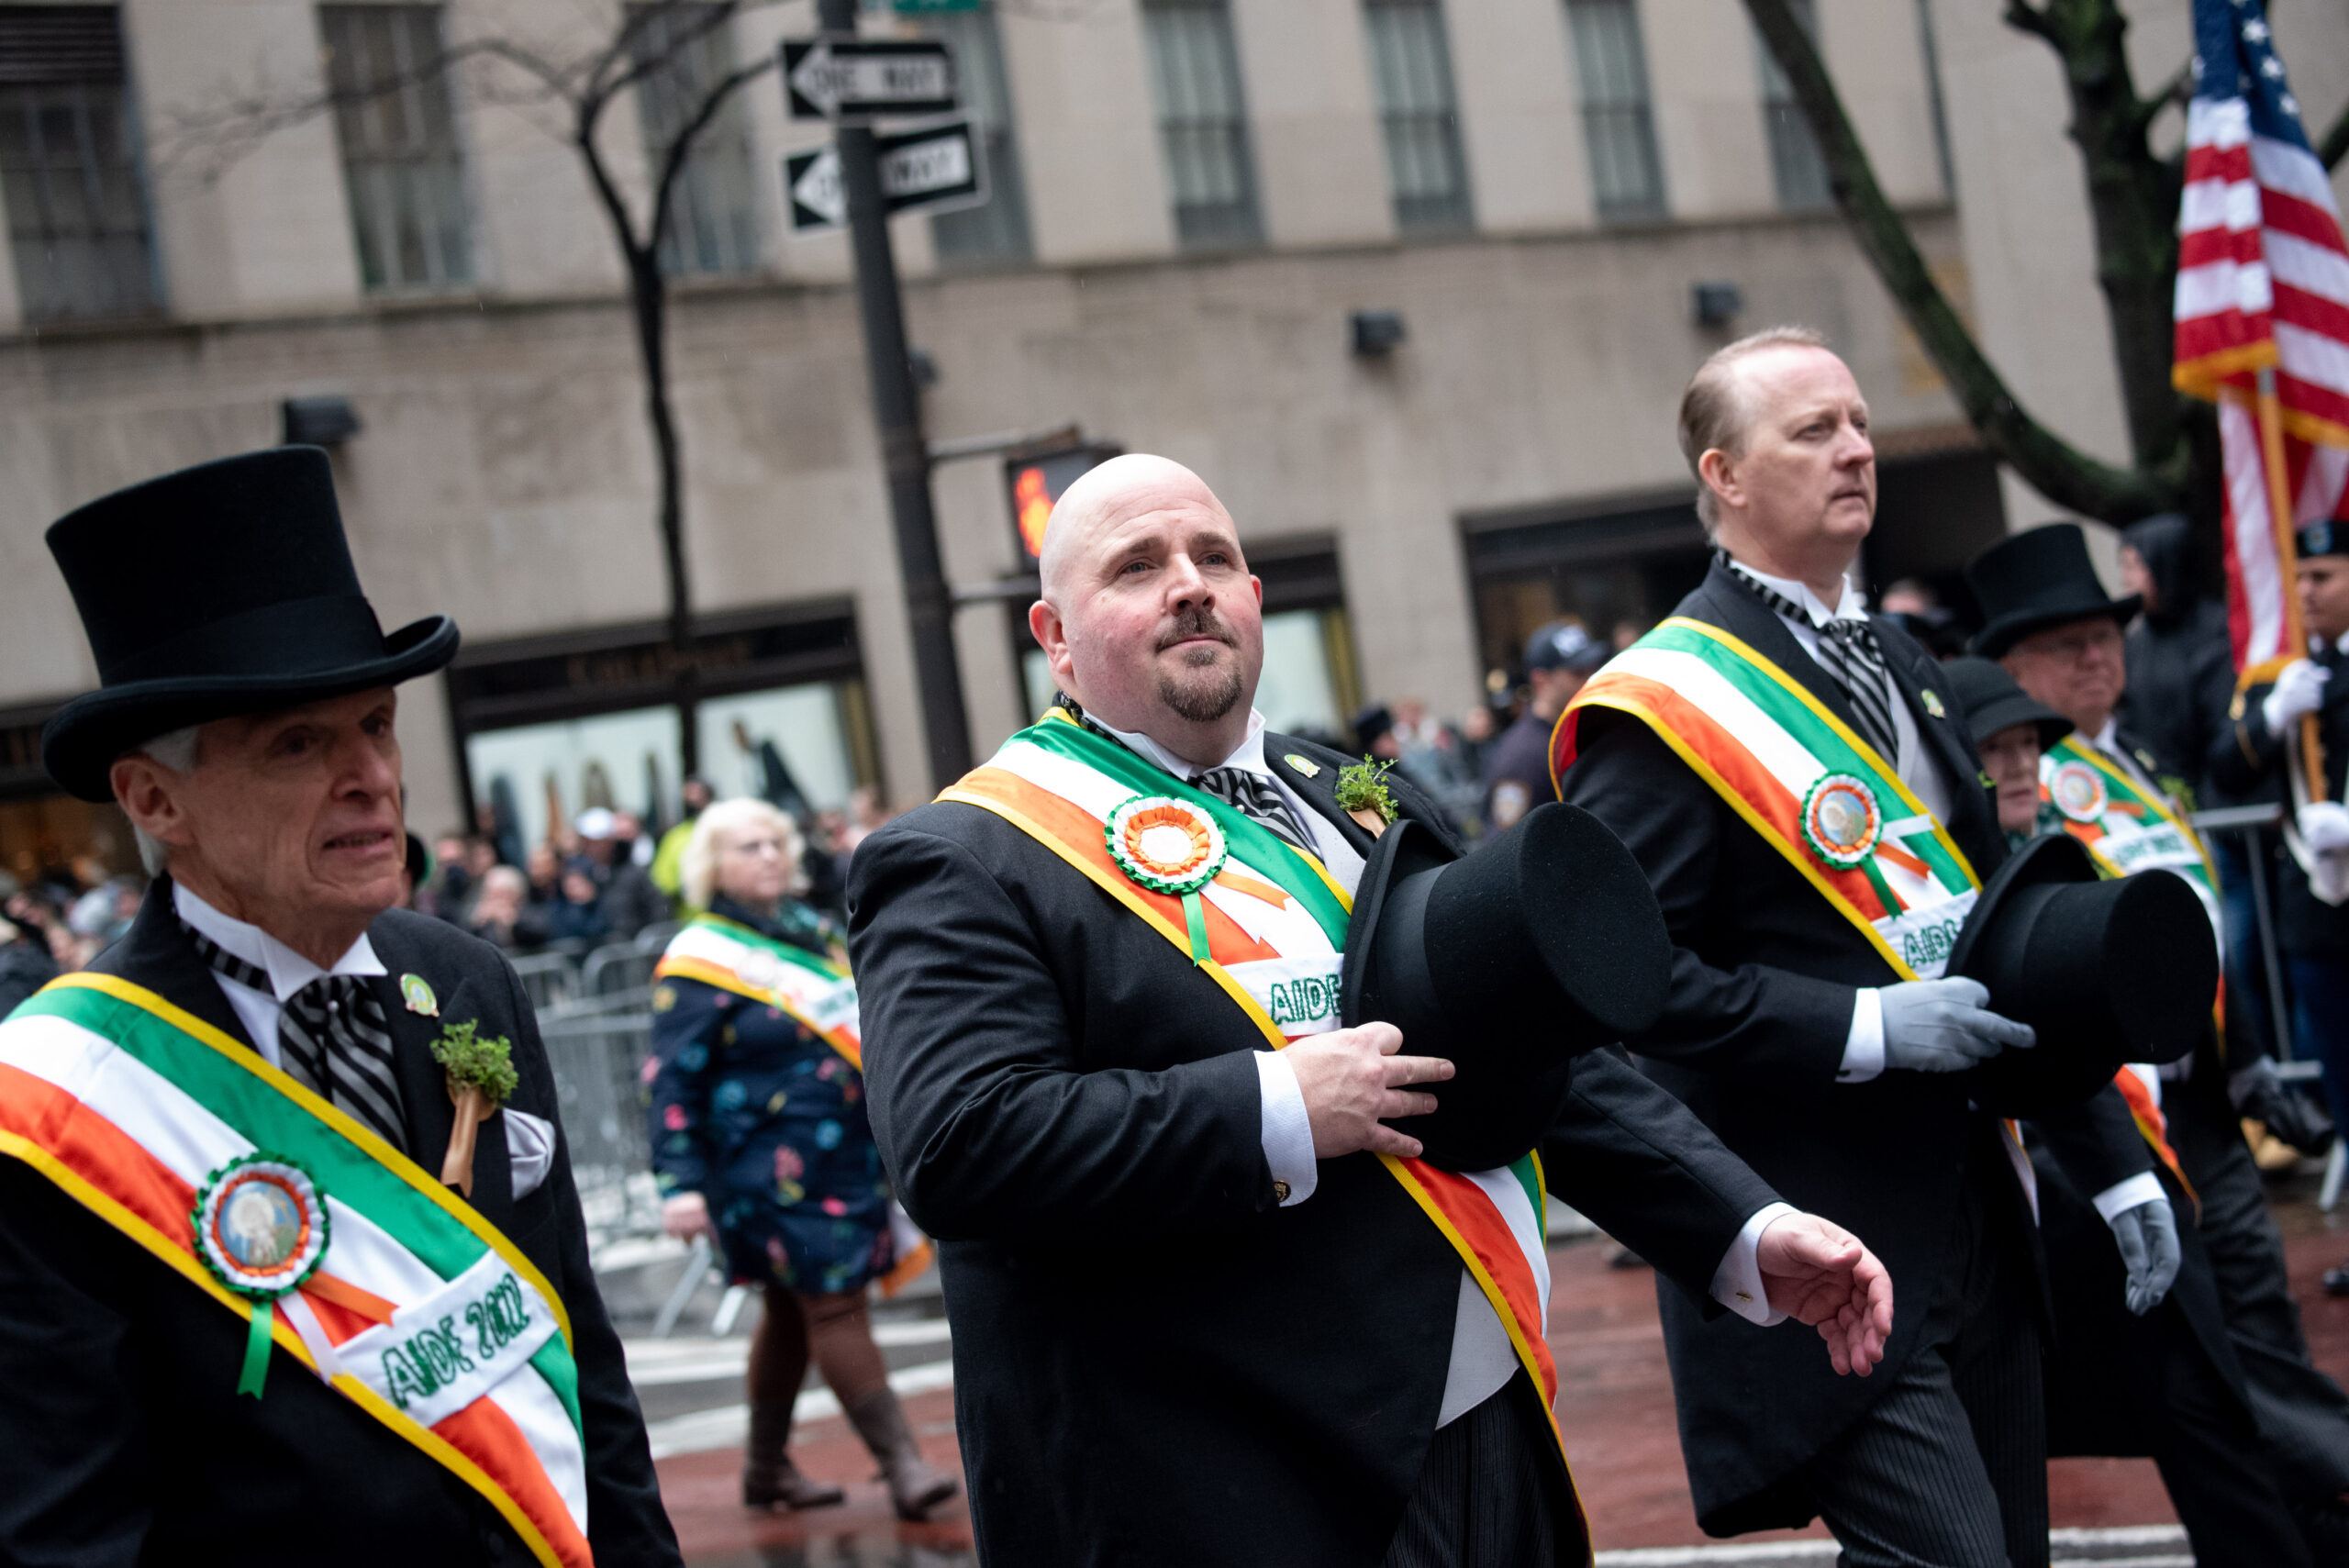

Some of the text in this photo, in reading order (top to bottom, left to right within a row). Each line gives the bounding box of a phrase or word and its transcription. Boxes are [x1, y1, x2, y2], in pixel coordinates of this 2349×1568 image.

[883, 65, 936, 90] WAY
[382, 1272, 530, 1409] AIDE 2022
